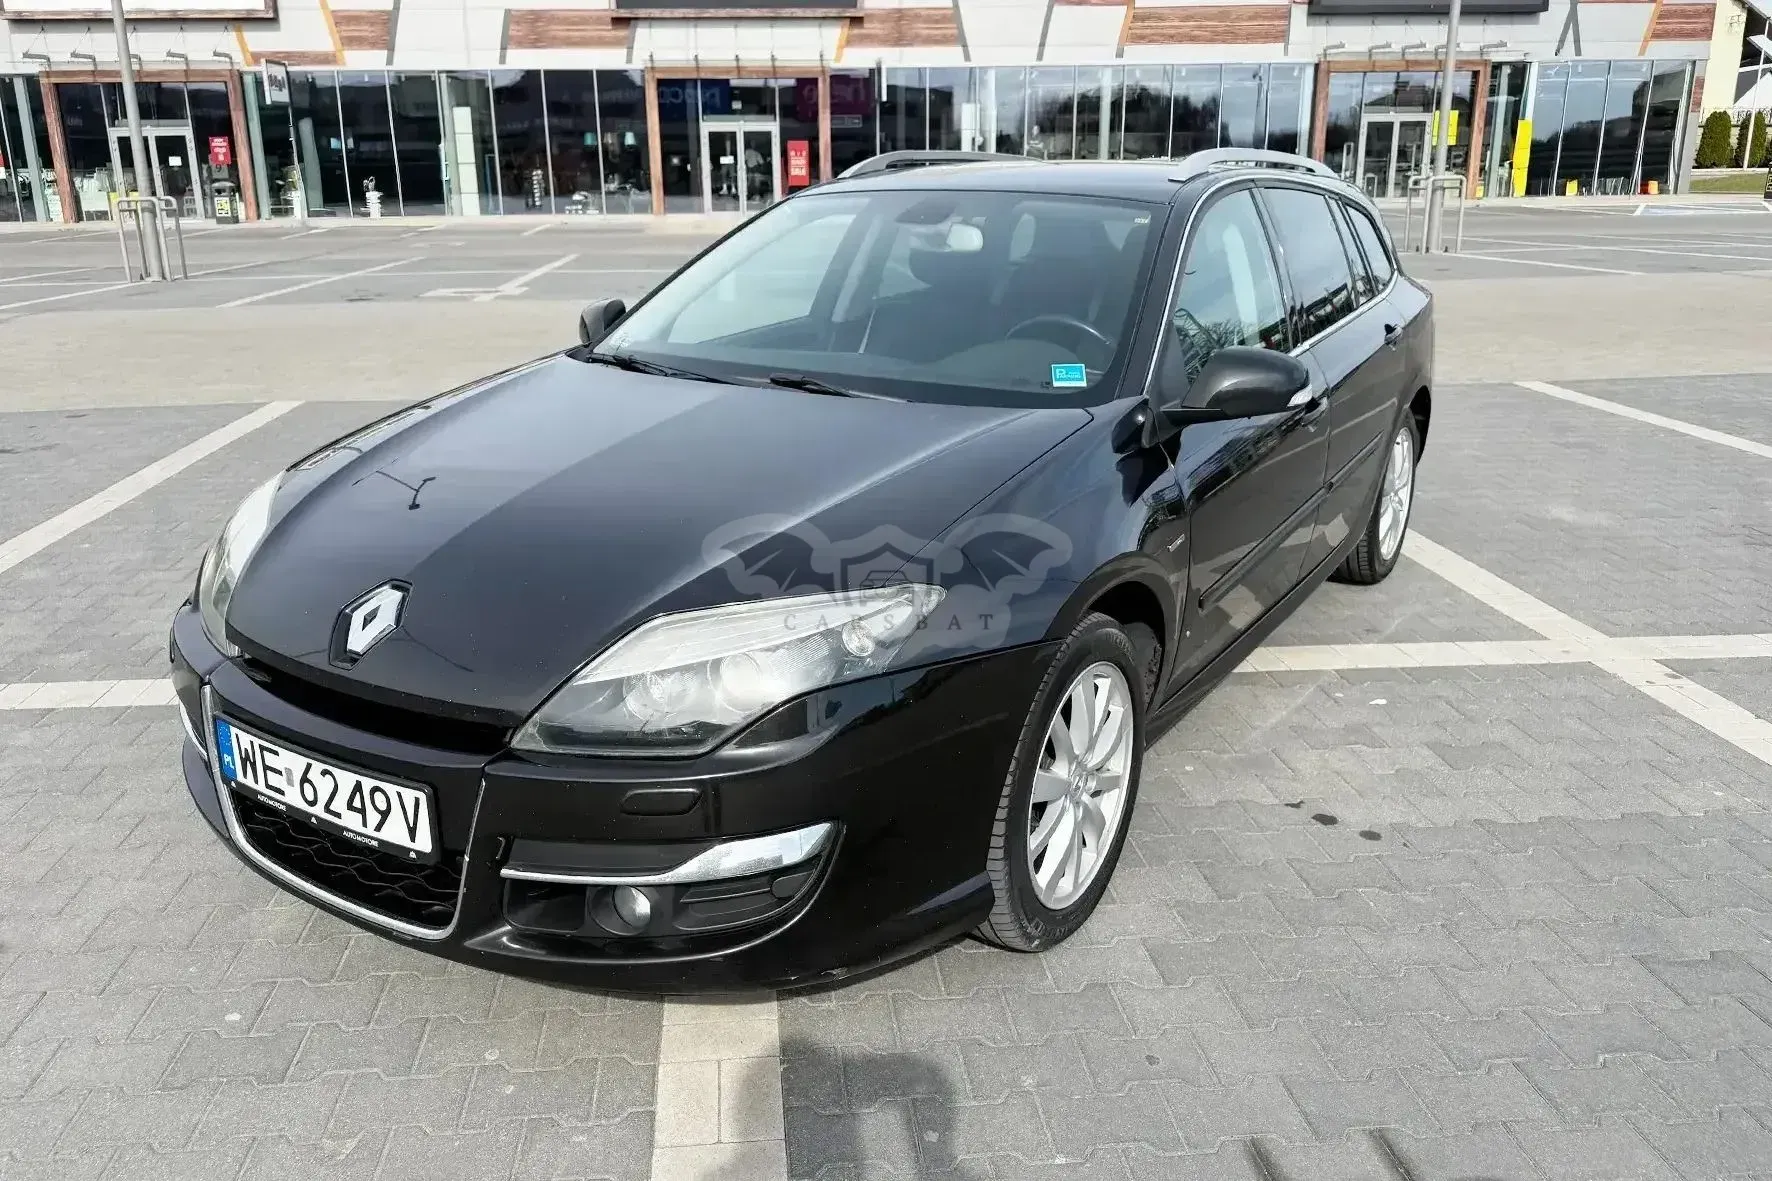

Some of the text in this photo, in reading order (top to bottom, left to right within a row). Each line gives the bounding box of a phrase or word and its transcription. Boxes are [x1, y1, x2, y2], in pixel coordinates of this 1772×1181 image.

[222, 754, 235, 770] PL
[236, 733, 420, 844] WE 6249V
